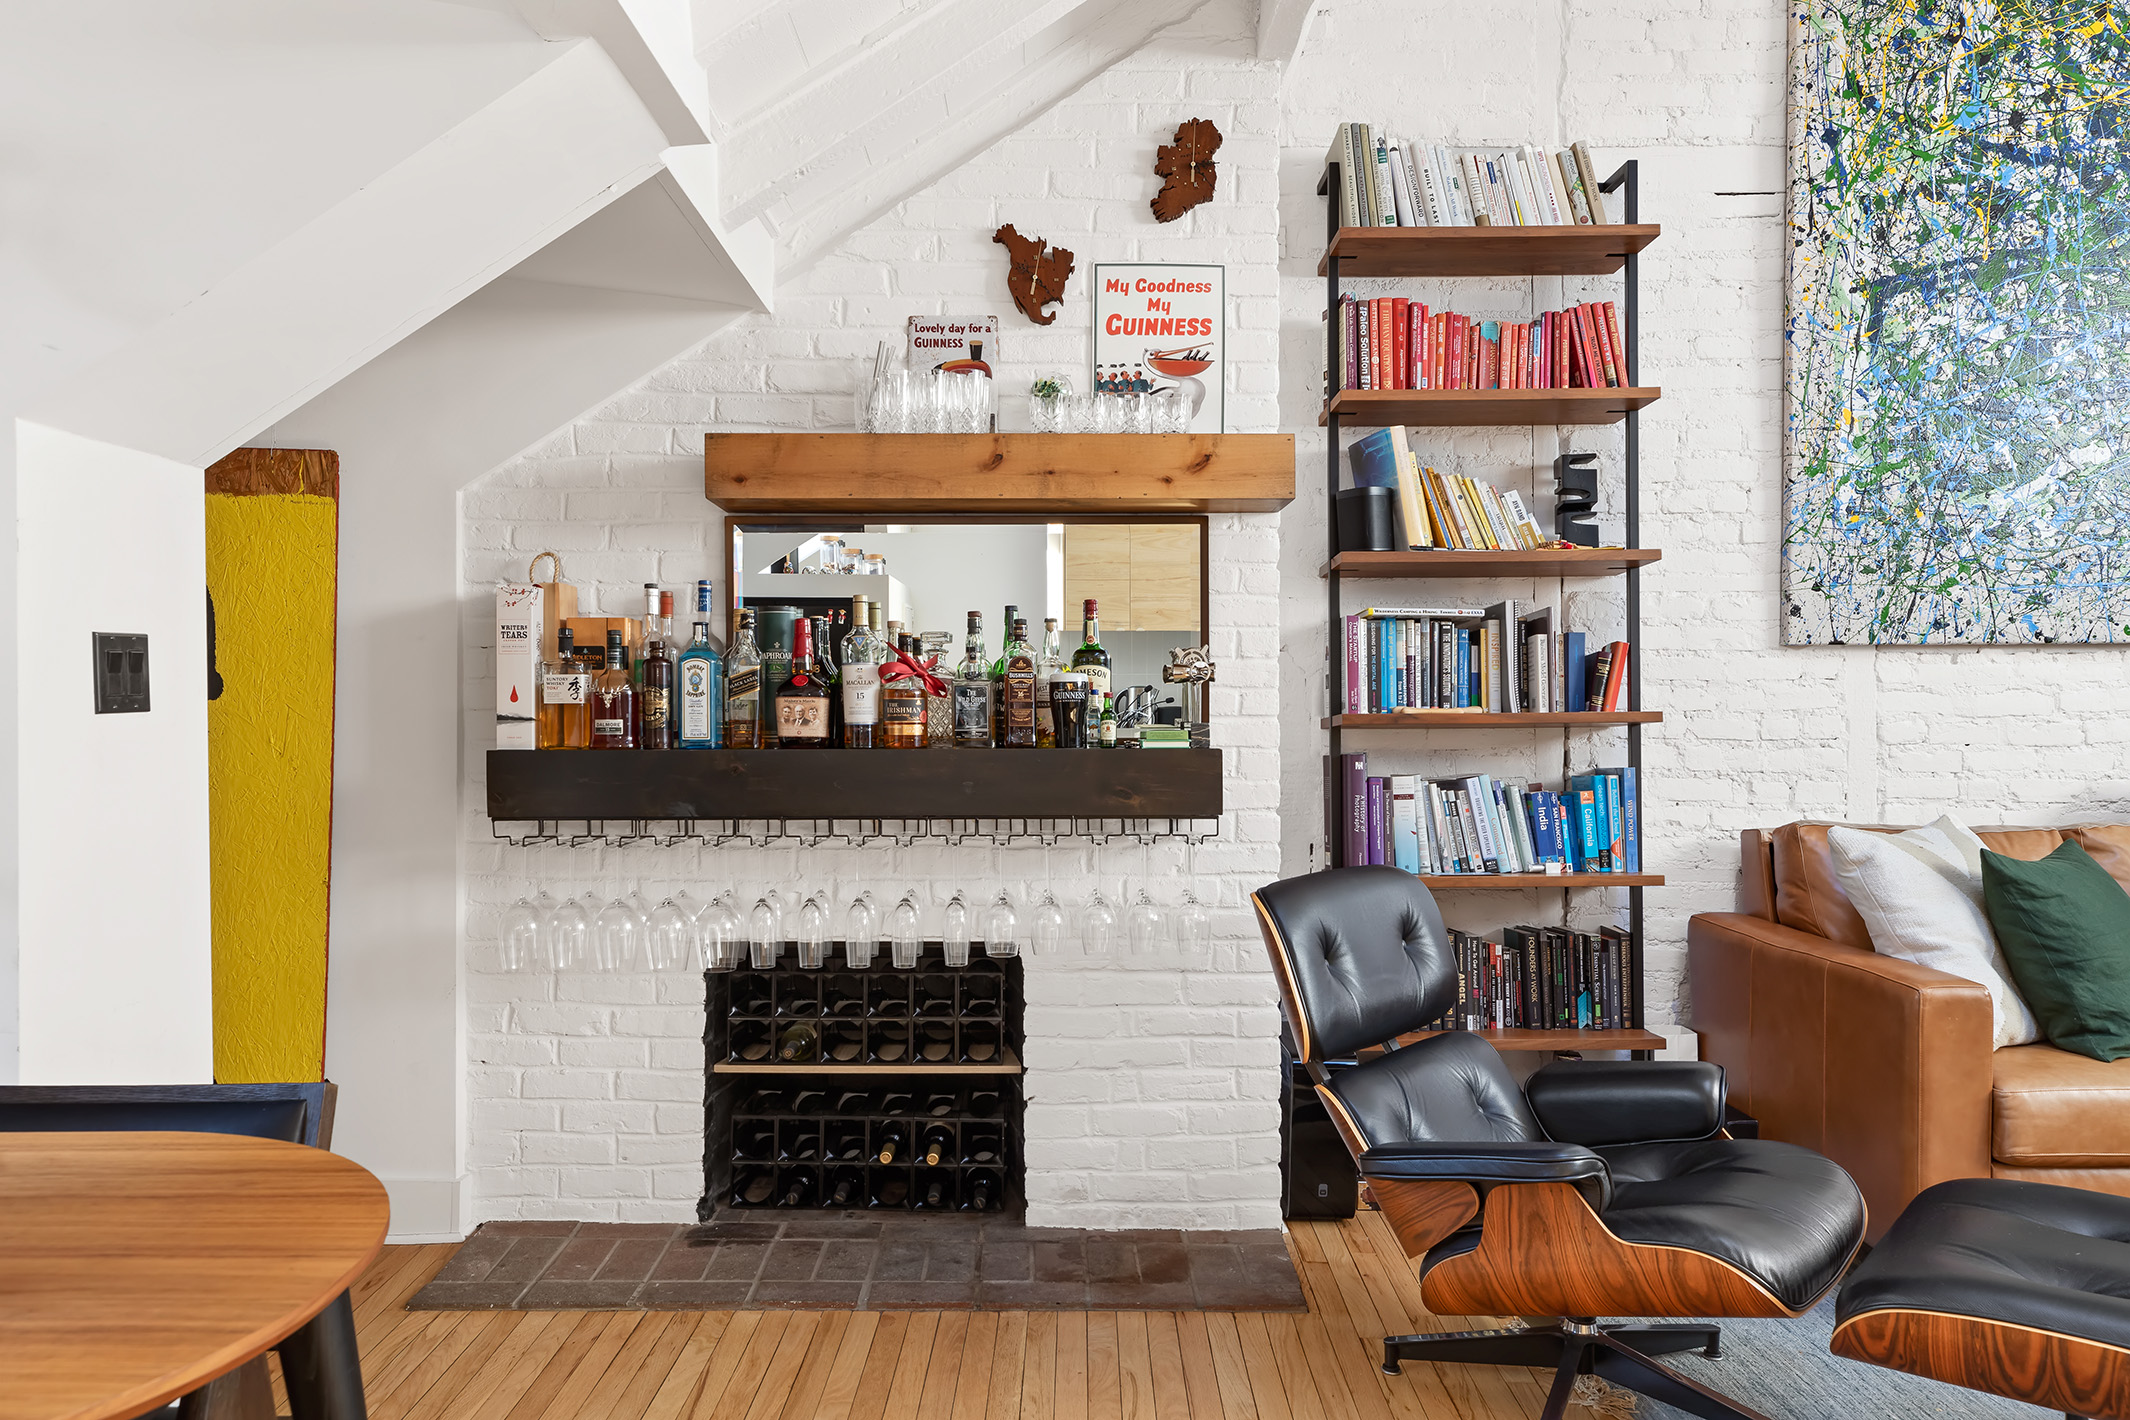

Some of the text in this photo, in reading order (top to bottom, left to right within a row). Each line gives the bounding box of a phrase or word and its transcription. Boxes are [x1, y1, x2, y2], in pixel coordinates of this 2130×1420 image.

[1567, 154, 1576, 175] Futebol
[1407, 165, 1424, 218] DESIGNFORWARD
[1424, 169, 1439, 223] BUILT TO LAST
[1106, 278, 1212, 296] My Goodness
[1147, 298, 1172, 316] My
[914, 323, 946, 334] Lovely
[948, 323, 966, 335] day
[969, 323, 982, 332] for
[1106, 313, 1212, 336] GUINNESS
[914, 336, 964, 348] GUINNESS
[1612, 333, 1621, 355] Presenter
[1382, 339, 1390, 373] EQUATION
[1516, 509, 1525, 521] RAND
[501, 631, 528, 639] TEARS
[686, 665, 705, 673] BOMBAY
[744, 675, 758, 683] LABEL
[1076, 669, 1108, 679] AMESON
[568, 676, 582, 700] 季
[686, 690, 706, 698] SAPPHIRE
[1054, 691, 1085, 699] GUINNESS
[1475, 797, 1483, 817] OBSERVING
[1482, 835, 1492, 856] EXPERIENCE
[1538, 806, 1548, 831] India
[1584, 808, 1594, 847] California
[1491, 817, 1505, 855] Connected
[1553, 819, 1562, 849] FRANCISCO
